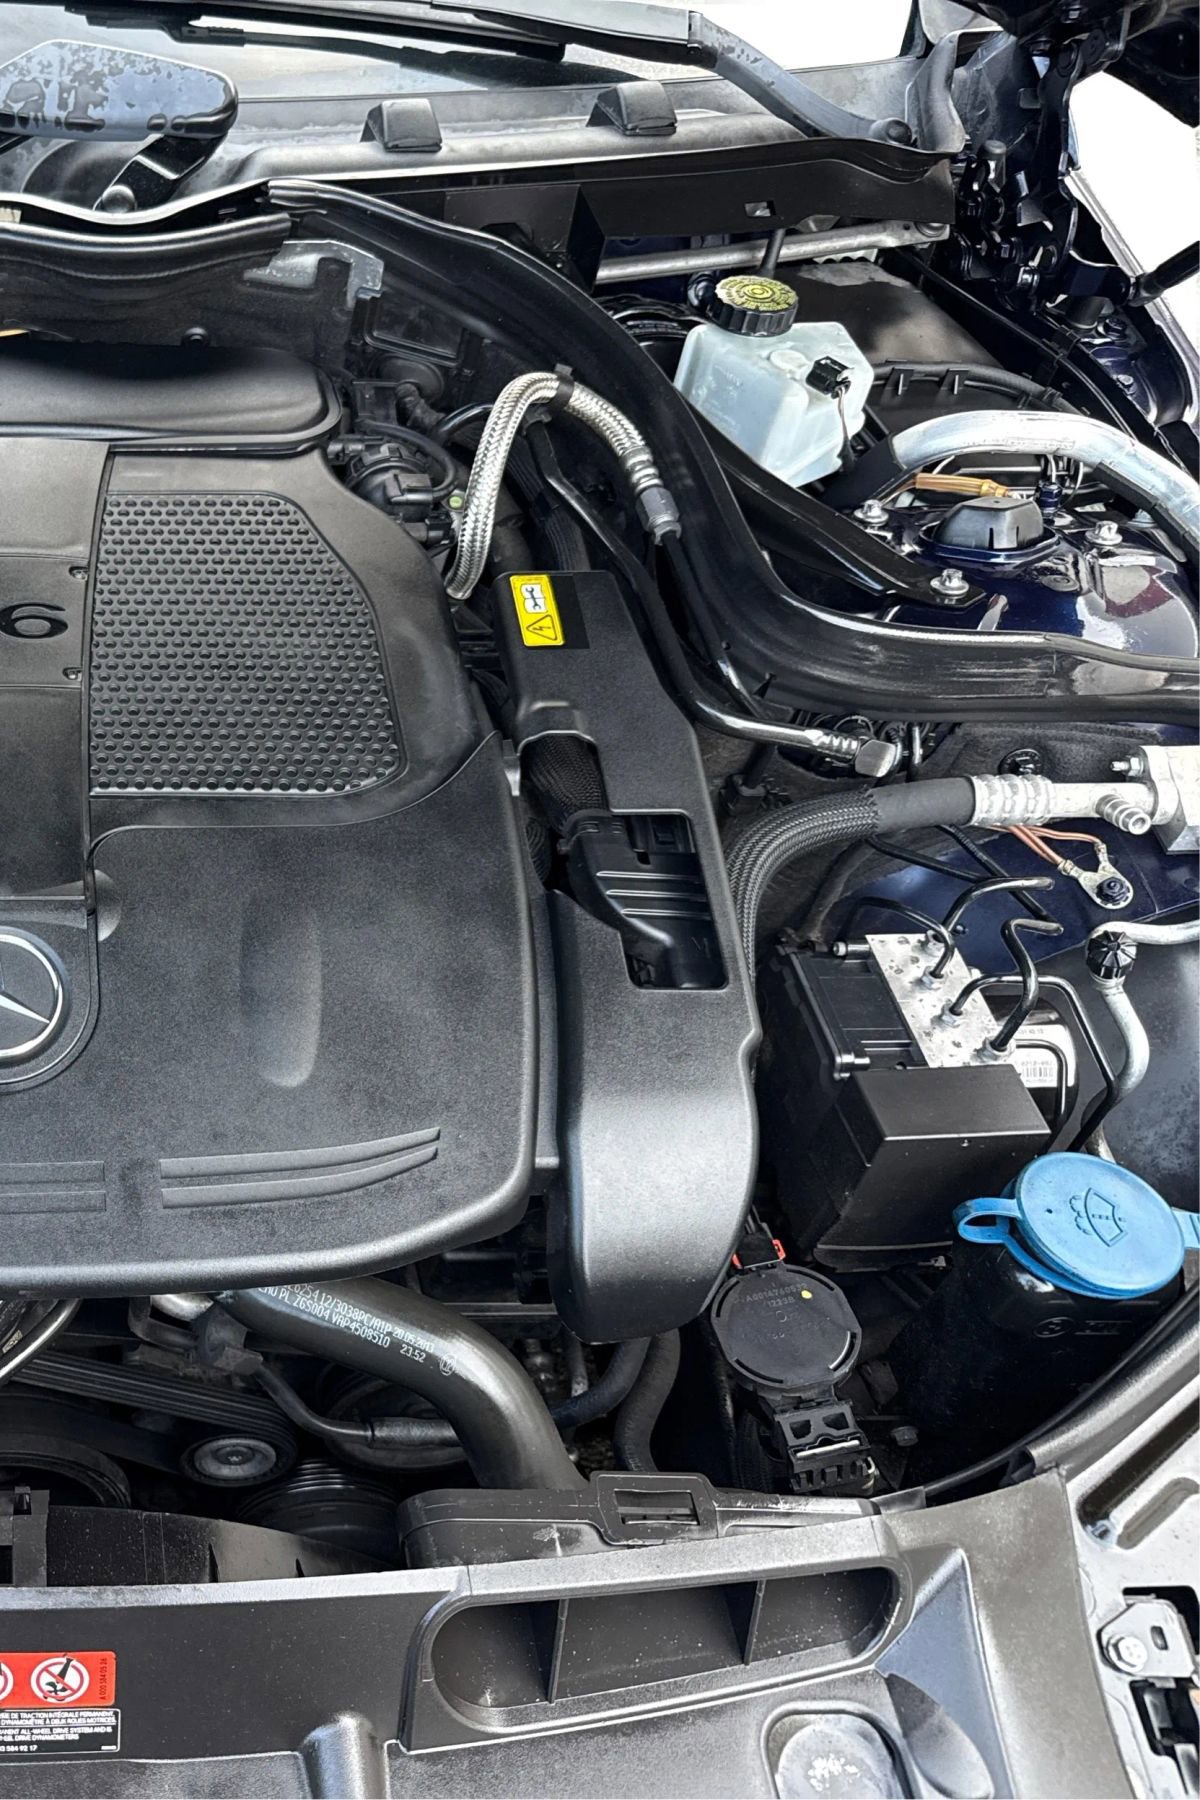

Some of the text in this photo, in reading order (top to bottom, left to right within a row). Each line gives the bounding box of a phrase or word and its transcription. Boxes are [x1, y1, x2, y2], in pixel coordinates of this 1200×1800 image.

[278, 1285, 292, 1305] PL
[331, 1311, 391, 1348] VAP4508510
[400, 1343, 426, 1363] 23:52
[29, 1744, 38, 1752] 17
